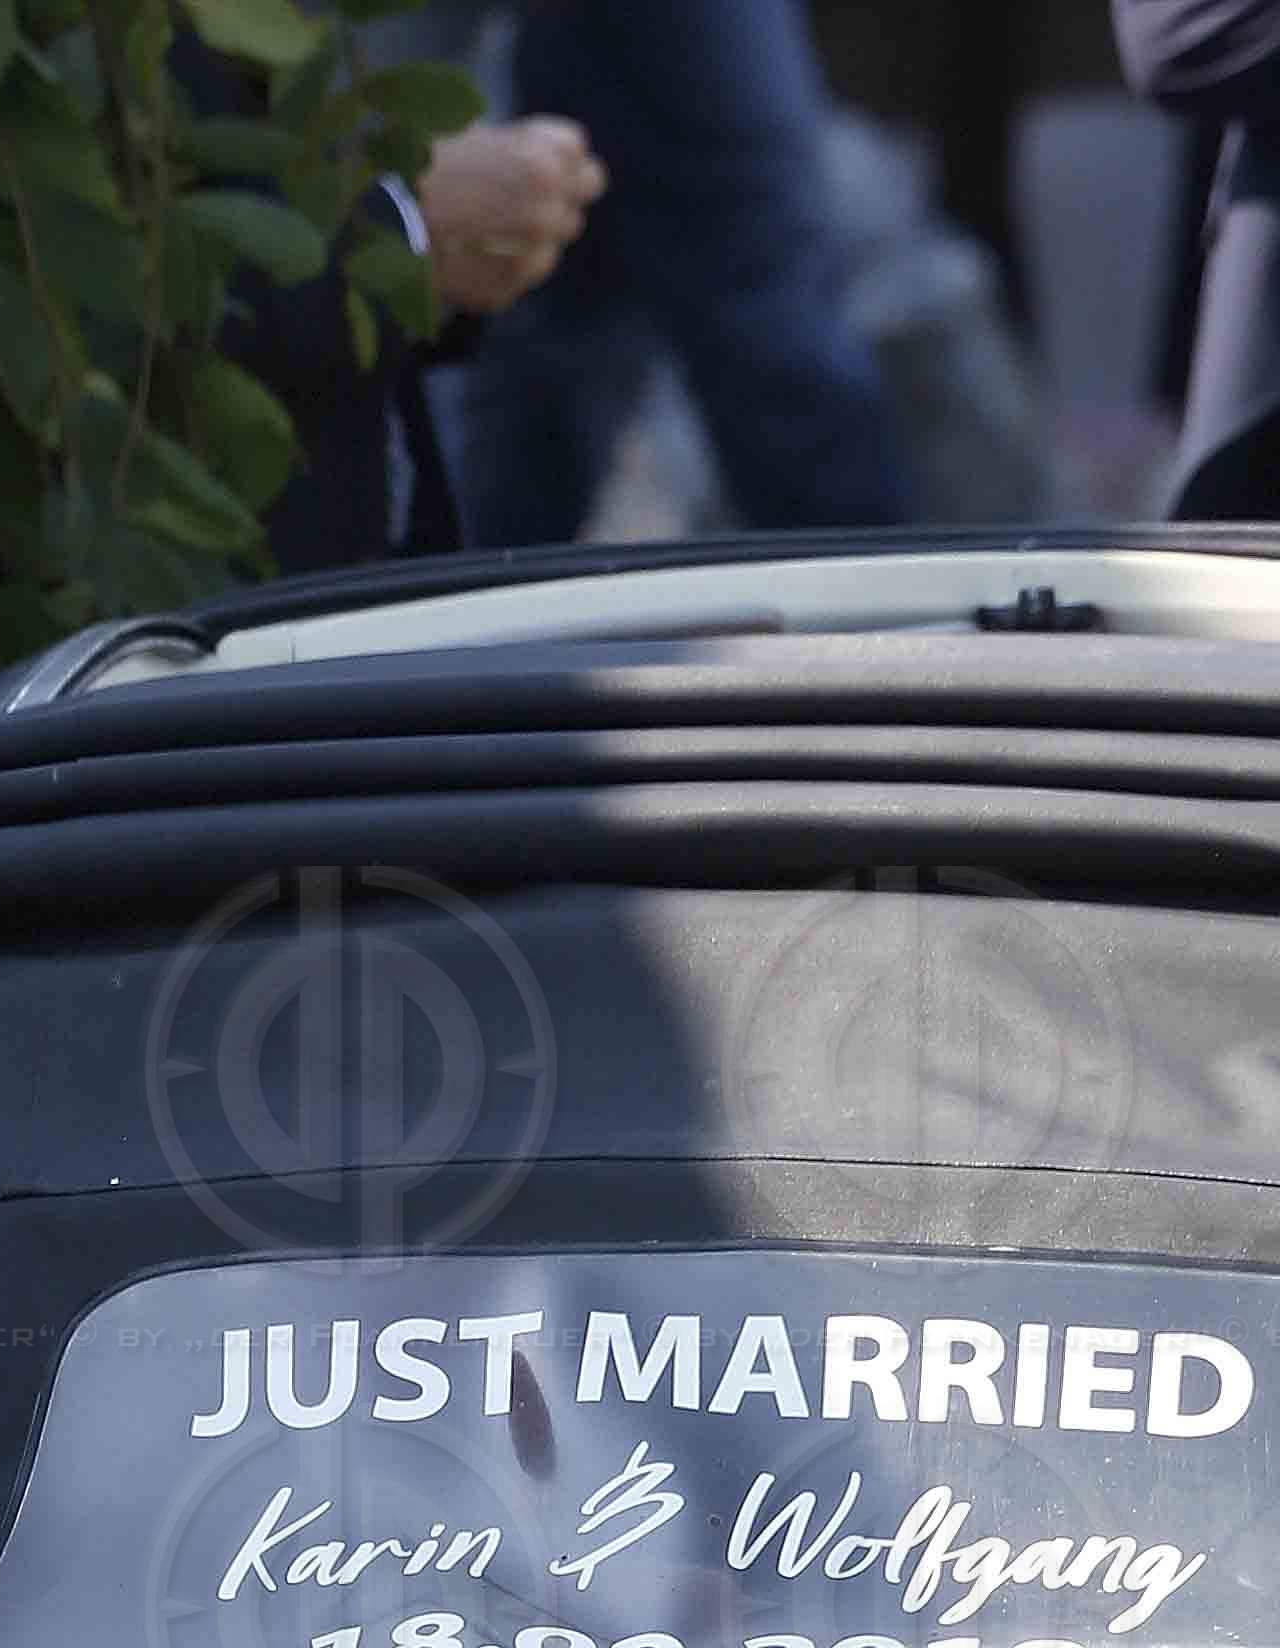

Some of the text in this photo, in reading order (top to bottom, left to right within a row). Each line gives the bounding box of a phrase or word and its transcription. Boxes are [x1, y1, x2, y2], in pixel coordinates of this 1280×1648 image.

[190, 1310, 1256, 1438] JUST MARRIED
[217, 1484, 503, 1604] Karin
[725, 1468, 1210, 1634] Wolfgang
